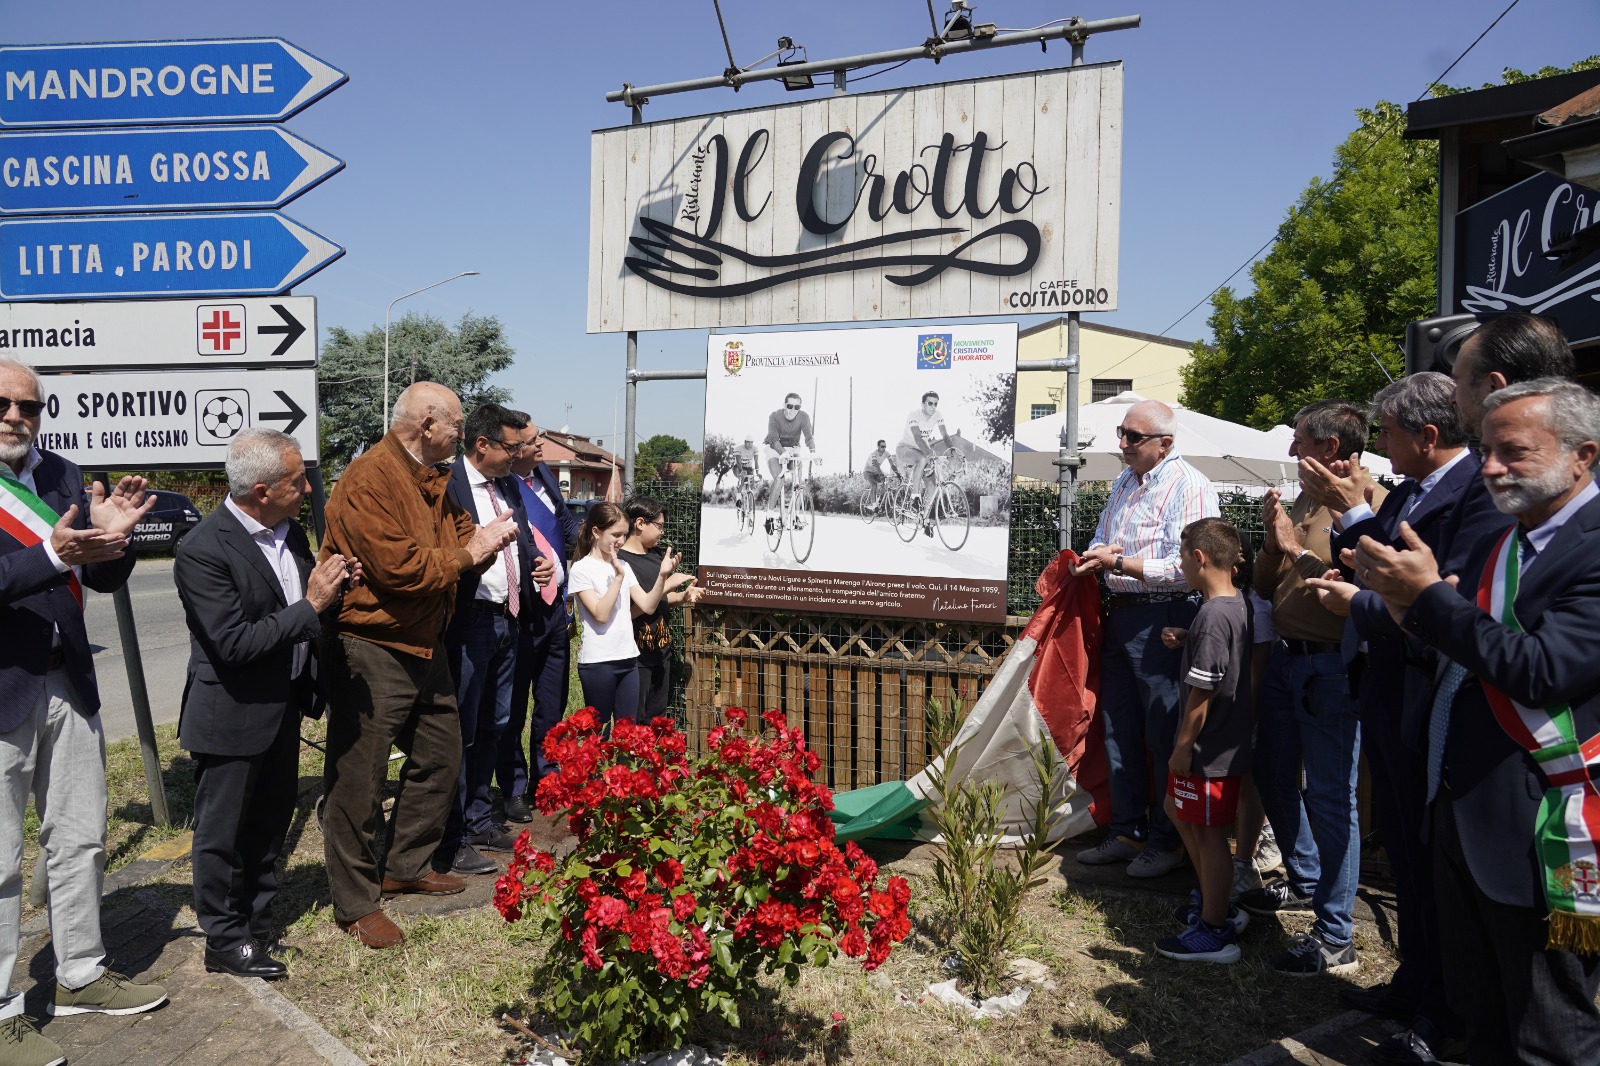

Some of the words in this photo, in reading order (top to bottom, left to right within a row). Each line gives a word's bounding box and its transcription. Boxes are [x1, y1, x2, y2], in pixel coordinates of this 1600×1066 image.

[6, 63, 275, 101] MANDROGNE
[3, 155, 133, 188] CASCINA
[150, 151, 270, 183] GROSSA
[796, 131, 1049, 235] Crotto
[681, 146, 706, 222] Ristorante
[19, 243, 103, 276] LITTA
[132, 240, 251, 272] PARODI
[1009, 288, 1108, 308] COSTADORO
[0, 319, 96, 348] armacia
[953, 339, 995, 347] MOVIMENTO
[77, 390, 187, 418] SPORTIVO
[87, 432, 93, 449] E
[101, 432, 127, 449] GIGI
[135, 430, 188, 448] CASSANO
[134, 523, 173, 533] SUZUKI
[134, 533, 172, 542] HYBRID
[959, 584, 980, 593] Marzo
